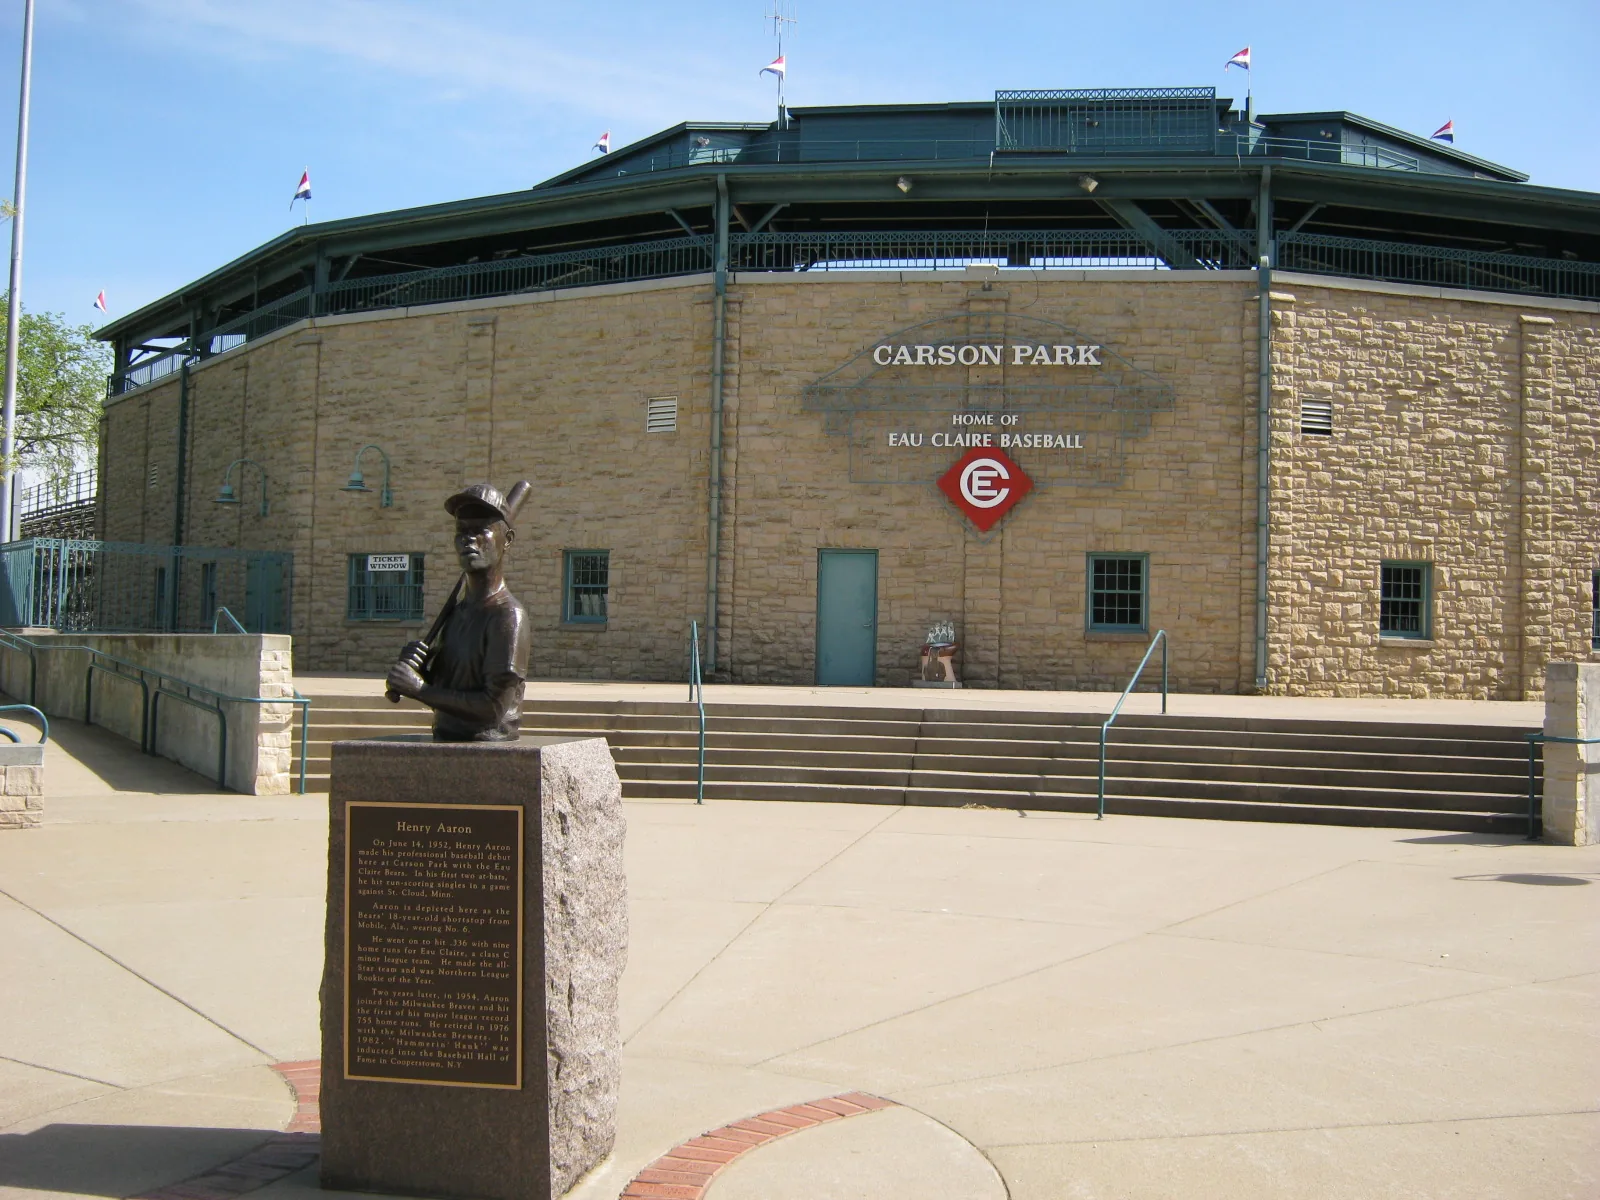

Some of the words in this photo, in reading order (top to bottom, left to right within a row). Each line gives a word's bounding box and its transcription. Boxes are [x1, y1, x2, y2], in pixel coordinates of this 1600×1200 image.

[873, 345, 1003, 366] CARSON
[1012, 345, 1101, 366] PARK
[952, 414, 994, 425] HOME
[1000, 414, 1019, 425] OF
[888, 432, 923, 447] EAU
[931, 432, 992, 447] CLAIRE
[1000, 433, 1083, 449] BASEBALL
[397, 821, 431, 835] Henry
[436, 823, 472, 834] Aaron
[372, 839, 385, 847] On
[388, 840, 407, 848] June
[455, 842, 481, 852] Henry
[484, 843, 511, 851] Aaron
[358, 848, 379, 856] made
[382, 849, 394, 857] his
[397, 850, 447, 860] professional
[451, 851, 483, 860] baseball
[487, 853, 511, 861] debut
[358, 858, 377, 866] here
[393, 859, 424, 867] Carson
[428, 860, 448, 868] Park
[452, 861, 471, 869] with
[476, 862, 490, 870] the
[494, 863, 510, 871] Eau
[358, 868, 381, 876] Claire
[426, 870, 437, 878] his
[371, 878, 382, 886] hit
[386, 879, 434, 890] run-scoring
[437, 881, 466, 891] singles
[489, 884, 510, 892] game
[358, 887, 384, 897] against
[372, 903, 399, 911] Aaron
[415, 904, 454, 915] depicted
[458, 906, 478, 914] here
[496, 907, 510, 915] the
[389, 913, 438, 924] 18-year-old
[442, 915, 485, 926] shortstop
[489, 917, 510, 925] from
[412, 923, 441, 934] wearing
[434, 938, 445, 946] hit
[471, 940, 489, 948] with
[492, 941, 510, 949] nine
[357, 945, 379, 953] home
[404, 947, 416, 955] for
[479, 950, 499, 958] class
[357, 955, 380, 963] minor
[384, 956, 408, 966] league
[441, 958, 451, 966] He
[456, 959, 476, 967] made
[480, 960, 492, 968] the
[357, 964, 374, 972] Star
[401, 966, 415, 974] and
[438, 968, 477, 977] Northern
[481, 970, 509, 980] League
[357, 974, 384, 982] Rookie
[387, 975, 396, 983] of
[399, 976, 411, 984] the
[372, 988, 389, 996] Two
[392, 991, 413, 999] years
[444, 992, 452, 1000] in
[483, 994, 509, 1002] Aaron
[357, 997, 382, 1008] joined
[385, 999, 398, 1007] the
[402, 1000, 445, 1009] Milwaukee
[449, 1002, 475, 1010] Braves
[479, 1003, 494, 1011] and
[497, 1004, 509, 1012] hit
[357, 1007, 369, 1015] the
[373, 1008, 391, 1016] first
[395, 1009, 404, 1017] of
[424, 1010, 447, 1021] major
[452, 1012, 477, 1022] league
[481, 1013, 509, 1022] record
[357, 1017, 372, 1025] 755
[376, 1018, 397, 1026] home
[429, 1020, 440, 1028] He
[444, 1021, 473, 1030] retired
[476, 1023, 485, 1031] in
[490, 1024, 509, 1032] 1976
[357, 1026, 376, 1035] with
[381, 1028, 394, 1036] the
[399, 1029, 446, 1038] Milwaukee
[500, 1034, 509, 1042] In
[357, 1046, 394, 1055] inducted
[398, 1048, 416, 1056] into
[420, 1049, 433, 1057] the
[437, 1050, 473, 1060] Baseball
[477, 1053, 496, 1061] Hall
[499, 1054, 509, 1062] of
[357, 1056, 376, 1064] Fame
[379, 1057, 387, 1065] in
